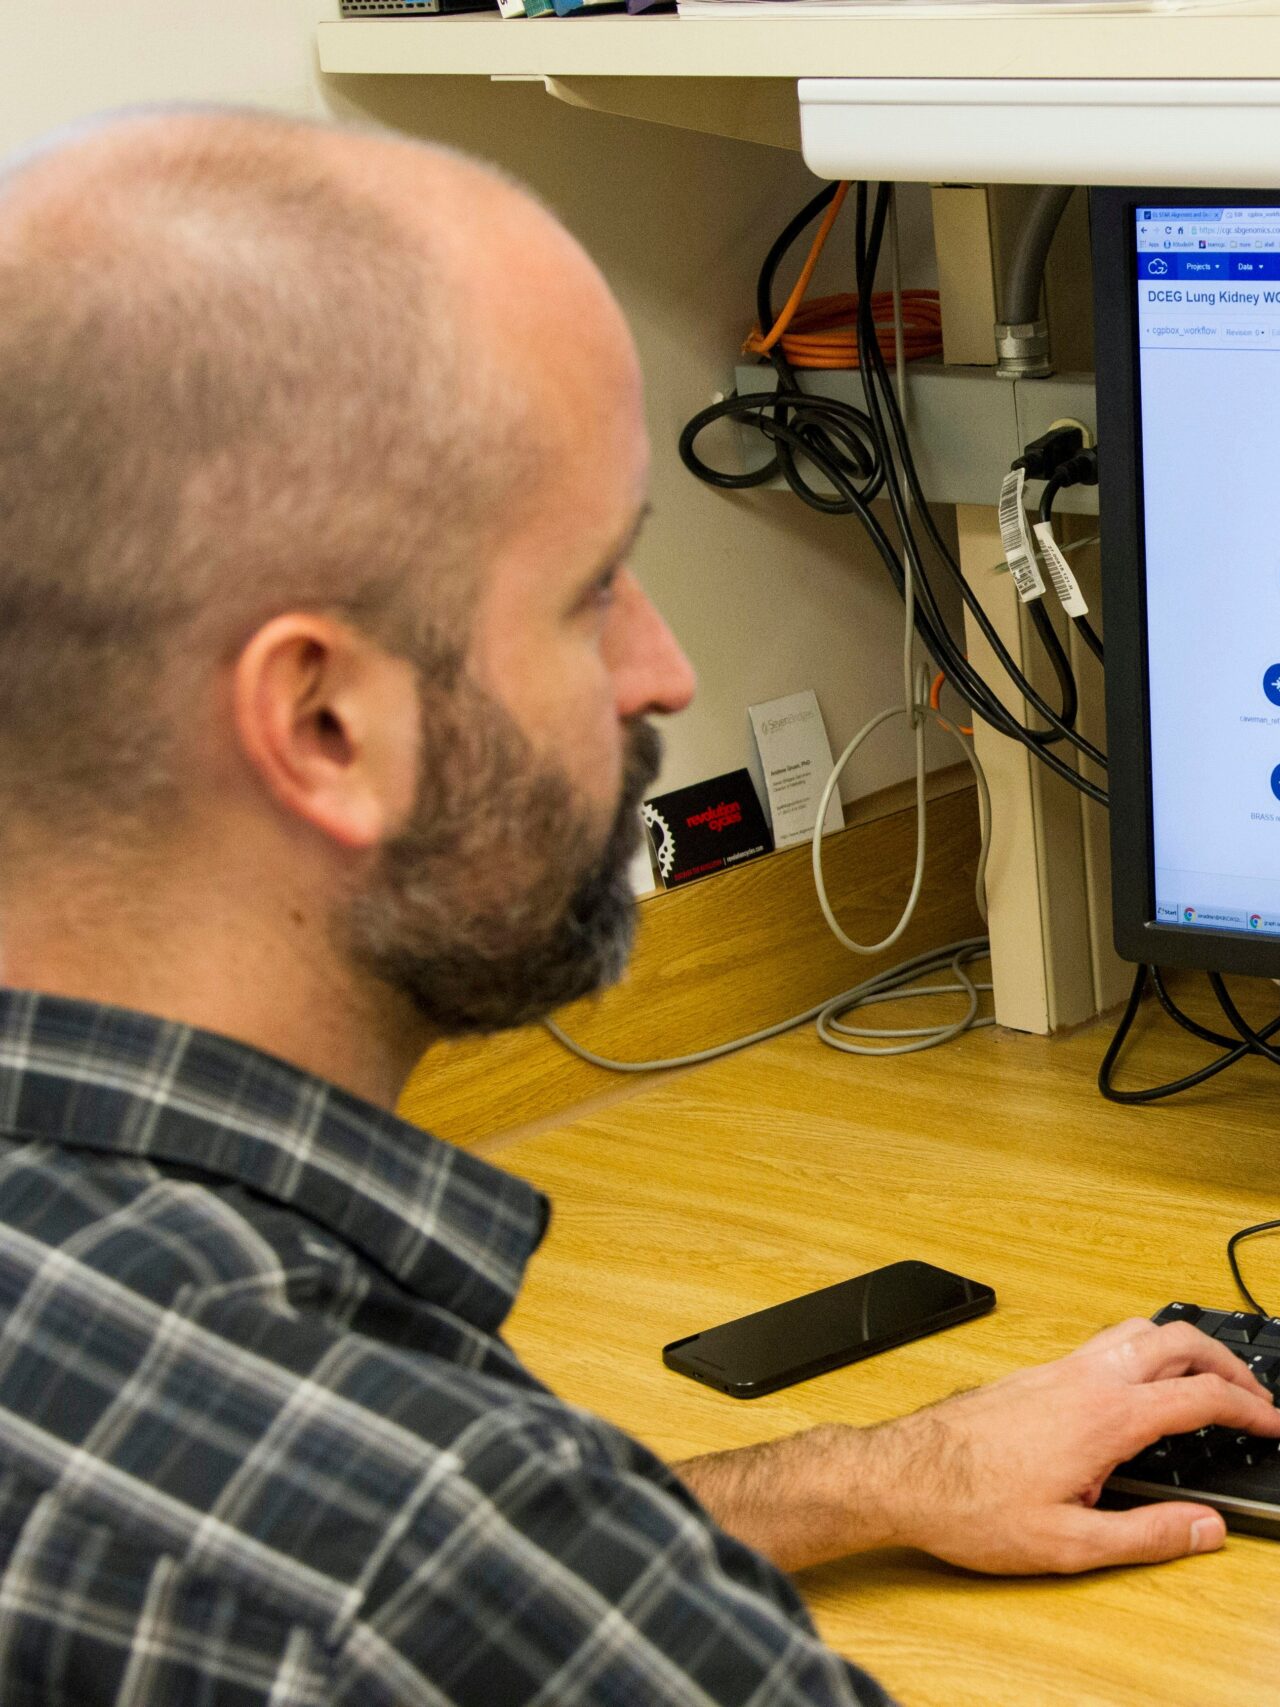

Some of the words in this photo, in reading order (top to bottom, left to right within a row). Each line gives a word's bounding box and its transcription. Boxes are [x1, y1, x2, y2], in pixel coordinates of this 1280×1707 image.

[1186, 262, 1211, 272] Projects
[1238, 262, 1253, 271] Data
[1148, 290, 1182, 302] DCEG
[1186, 291, 1215, 306] Lung
[1219, 291, 1260, 306] Kidney
[1152, 326, 1217, 337] cgpbox_workflow
[686, 801, 742, 828] revolution
[1250, 812, 1274, 822] BRASS
[708, 812, 743, 833] cycles
